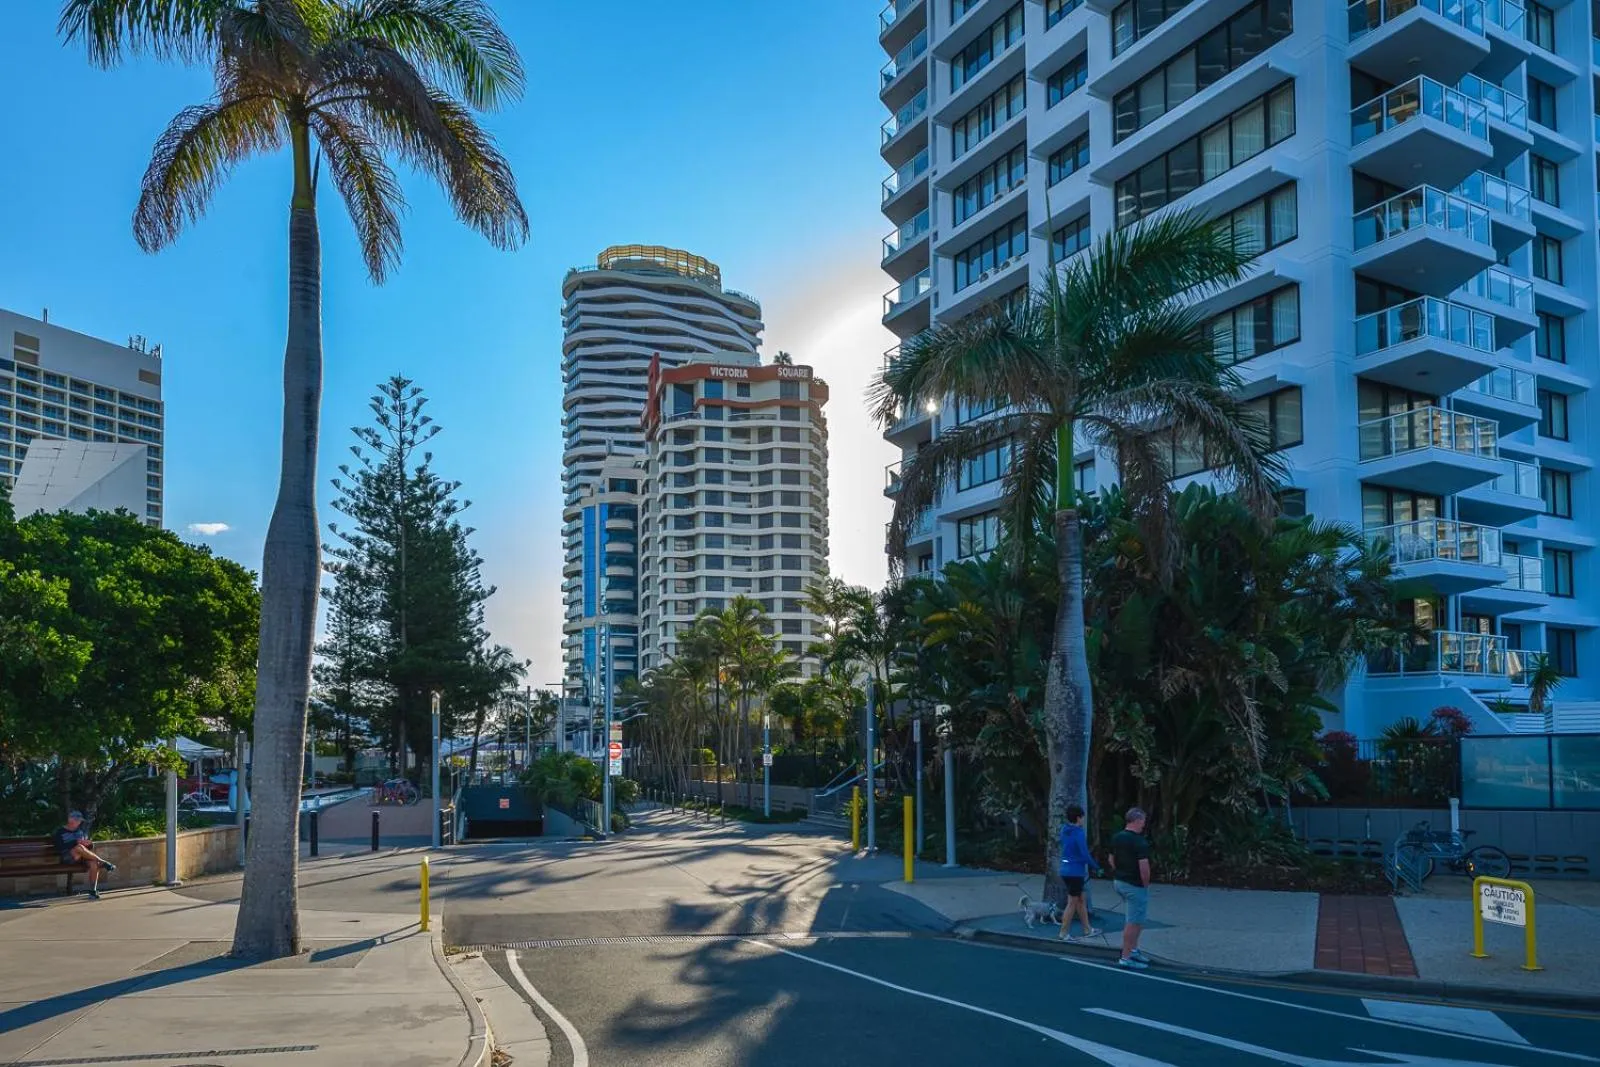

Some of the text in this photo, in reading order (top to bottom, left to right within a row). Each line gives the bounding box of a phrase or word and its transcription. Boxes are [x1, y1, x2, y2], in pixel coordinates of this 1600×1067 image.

[710, 367, 809, 379] VICTORIA SQUARE
[1484, 888, 1523, 902] CAUTION
